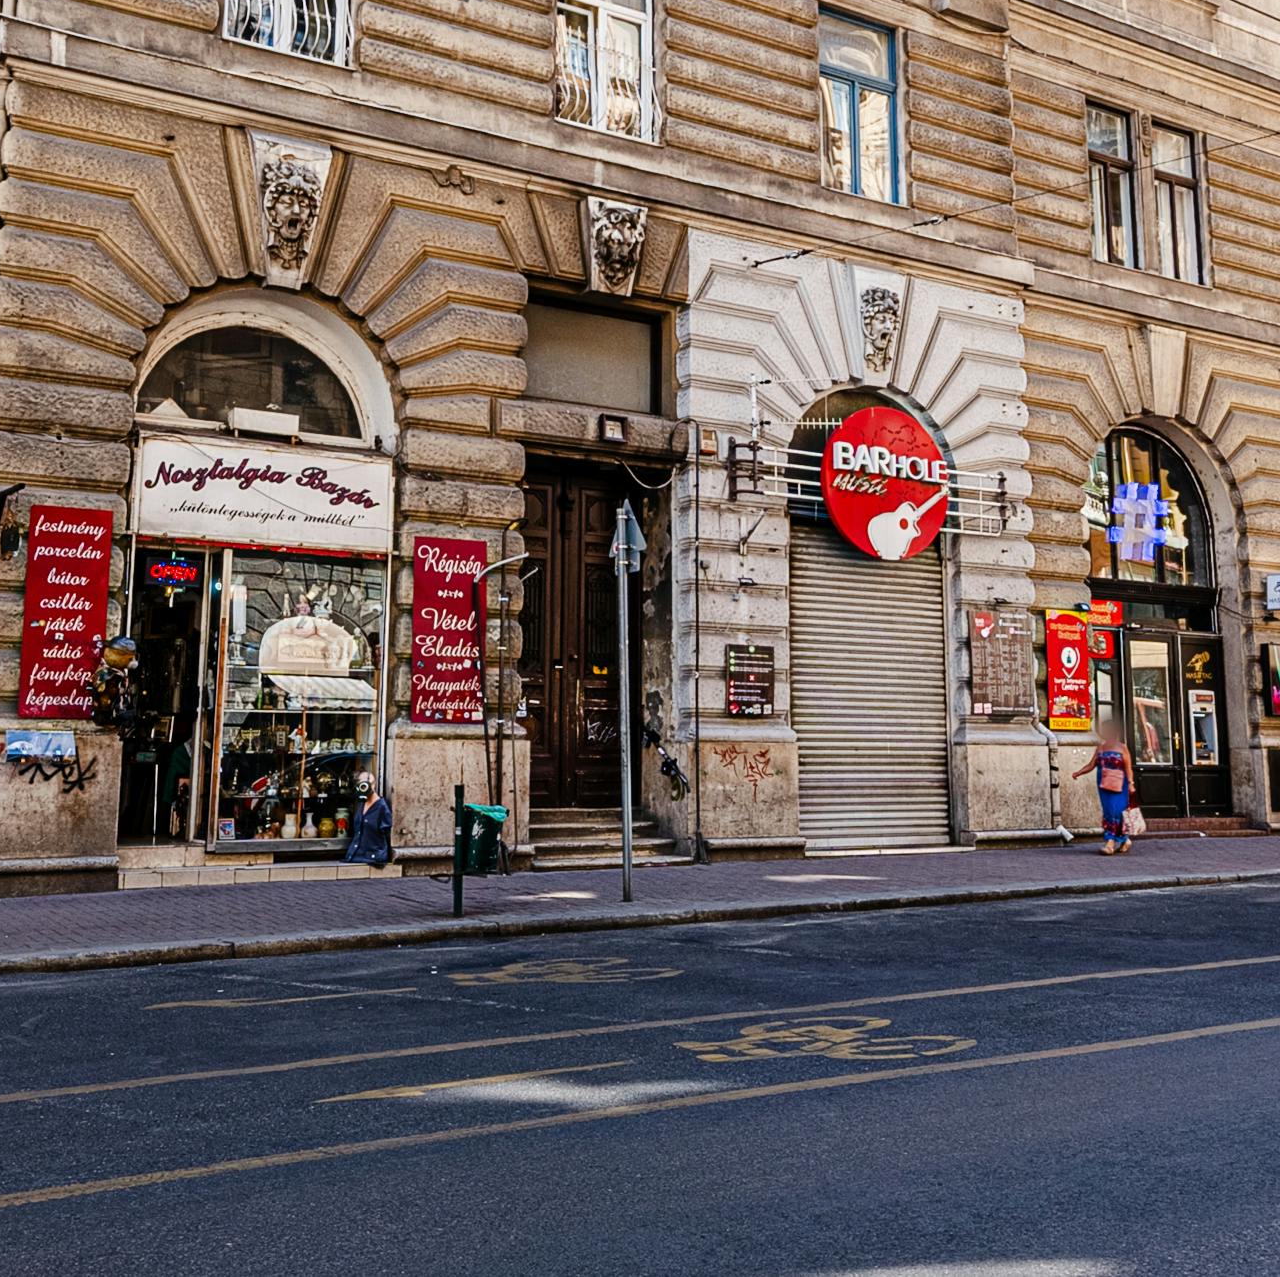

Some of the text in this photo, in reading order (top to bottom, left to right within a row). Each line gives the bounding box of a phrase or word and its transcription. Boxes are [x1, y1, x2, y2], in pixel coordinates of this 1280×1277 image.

[832, 441, 948, 483] BARHOLE
[144, 458, 380, 509] Nosztalgia Bazár
[35, 515, 106, 541] festmény
[34, 542, 104, 561] porcelán
[150, 564, 198, 581] OPEN
[417, 545, 484, 583] Régiség
[47, 567, 90, 586] bútor
[40, 593, 93, 611] csillár
[44, 615, 86, 635] játék
[421, 608, 477, 631] Vétel
[43, 642, 83, 659] rádió
[415, 635, 480, 657] Eladás
[30, 663, 93, 686] fénykép
[413, 674, 481, 696] Hagyaték
[26, 690, 94, 711] képeslap
[416, 696, 483, 714] felvásárlás
